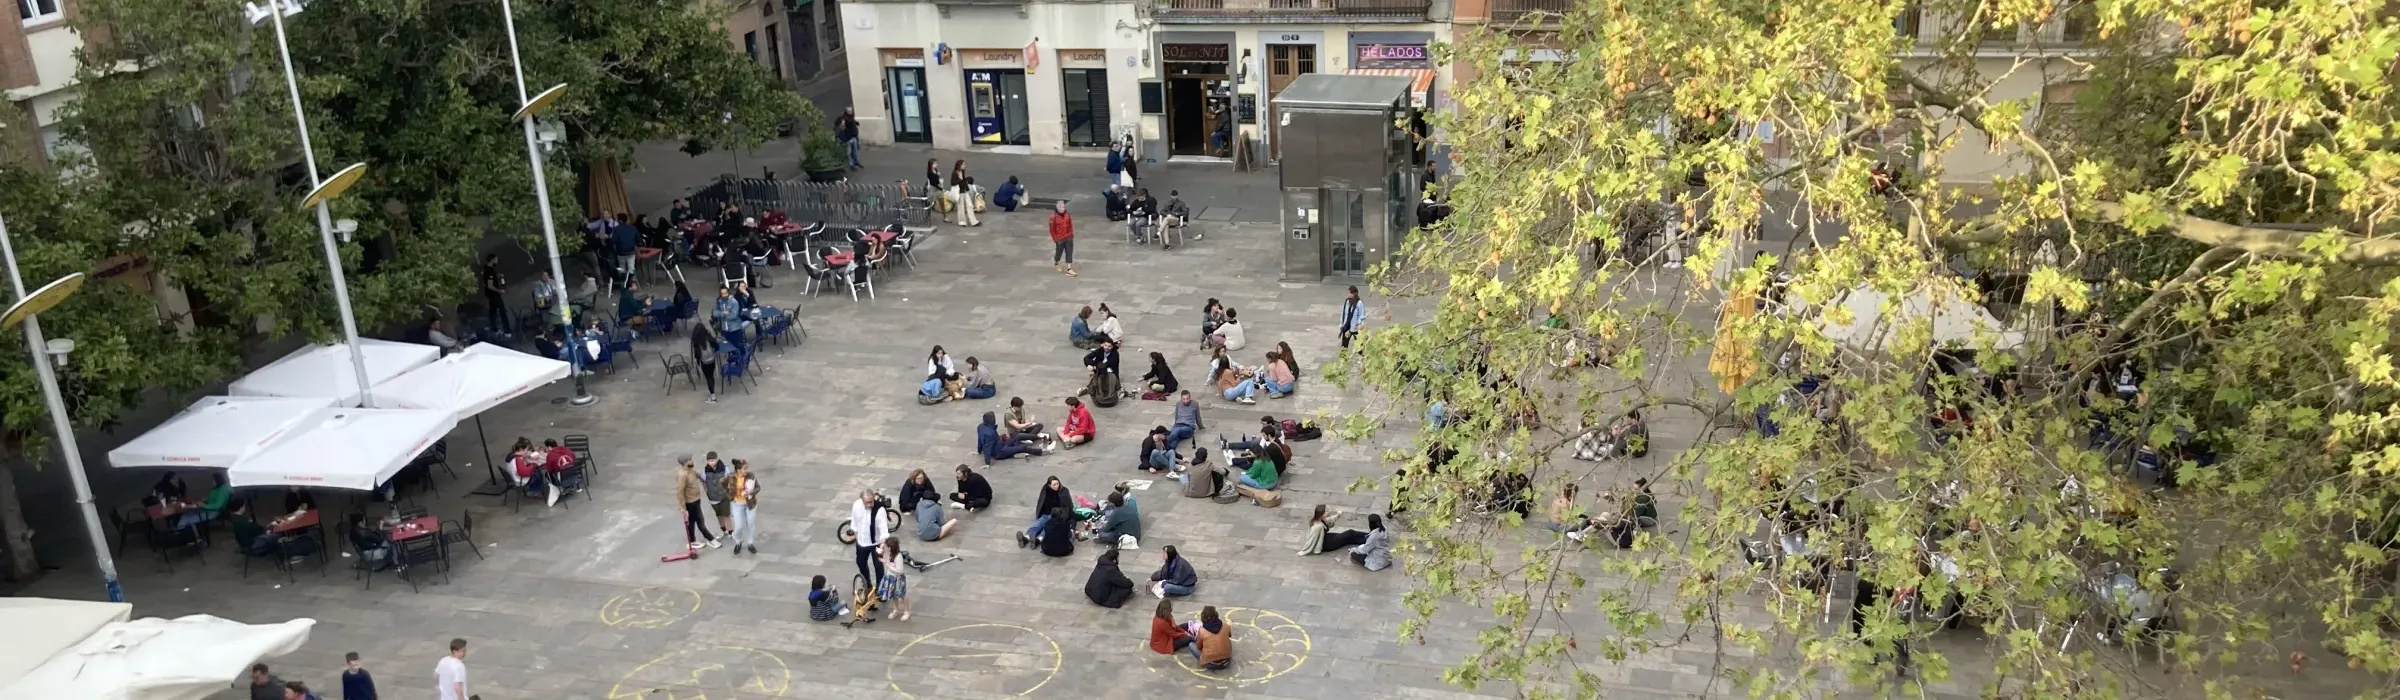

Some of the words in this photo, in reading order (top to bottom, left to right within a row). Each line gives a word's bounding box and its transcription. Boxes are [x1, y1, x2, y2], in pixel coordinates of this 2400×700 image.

[983, 52, 1017, 63] Laundry
[1163, 46, 1187, 58] SOL
[1200, 47, 1227, 58] NIT
[1362, 47, 1422, 58] HELADOS
[972, 72, 991, 81] ATM
